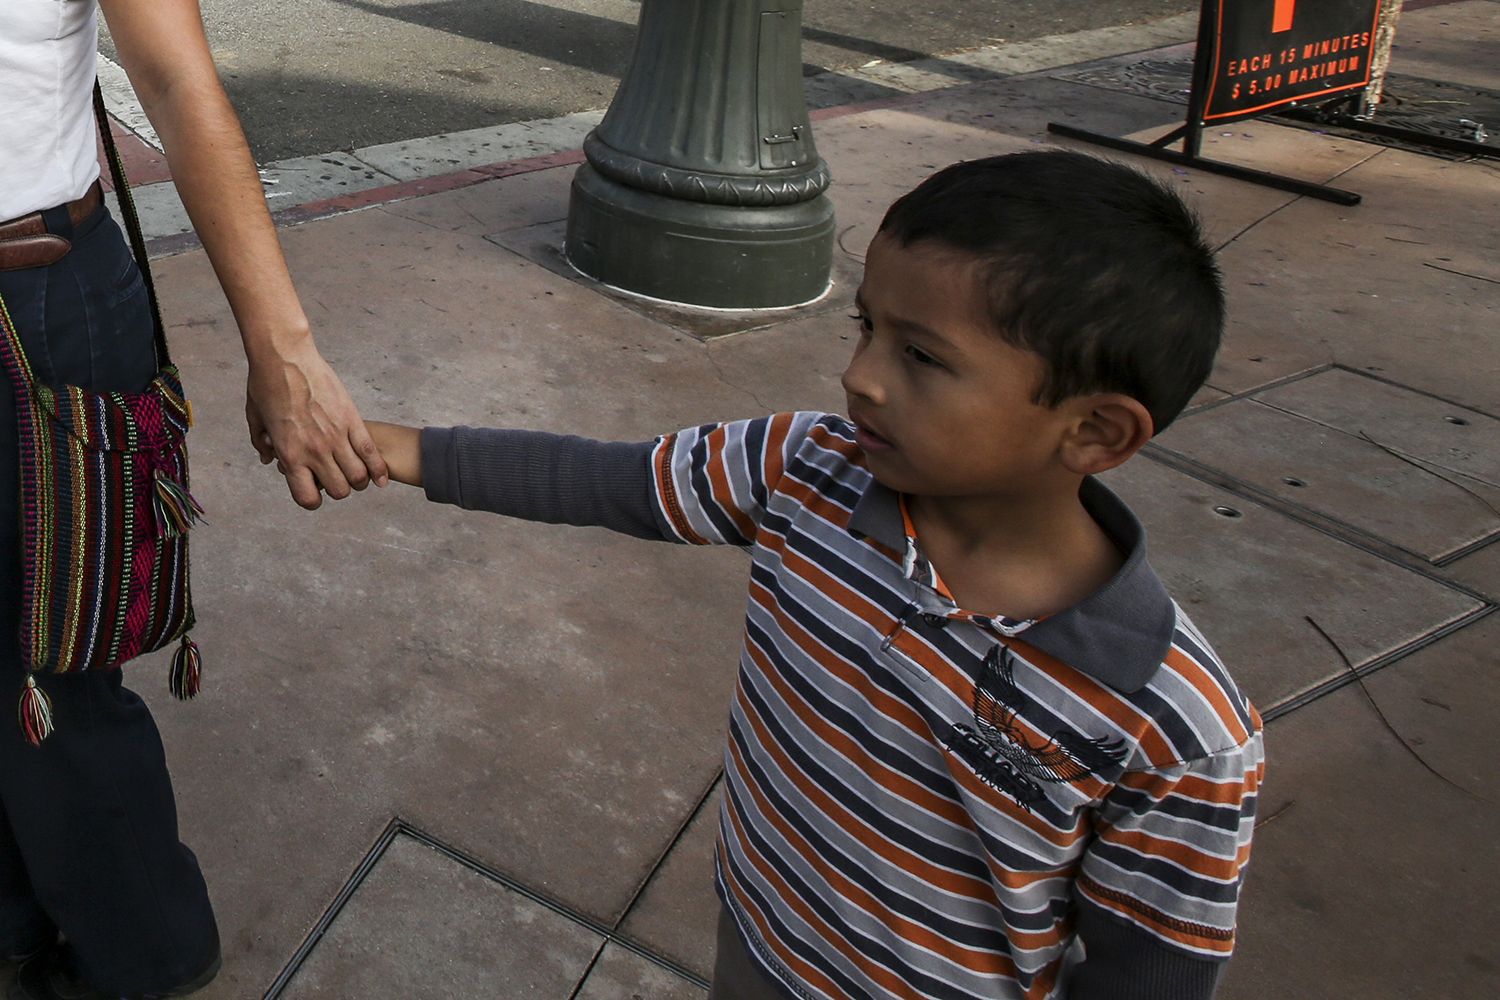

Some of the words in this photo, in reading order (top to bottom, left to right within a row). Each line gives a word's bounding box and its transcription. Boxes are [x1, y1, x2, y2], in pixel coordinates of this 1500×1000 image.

[1228, 53, 1272, 78] EACH
[1279, 46, 1297, 64] 15
[1302, 31, 1371, 61] MINUTES
[1248, 73, 1282, 96] 5.00
[1289, 55, 1361, 85] MAXIMUM
